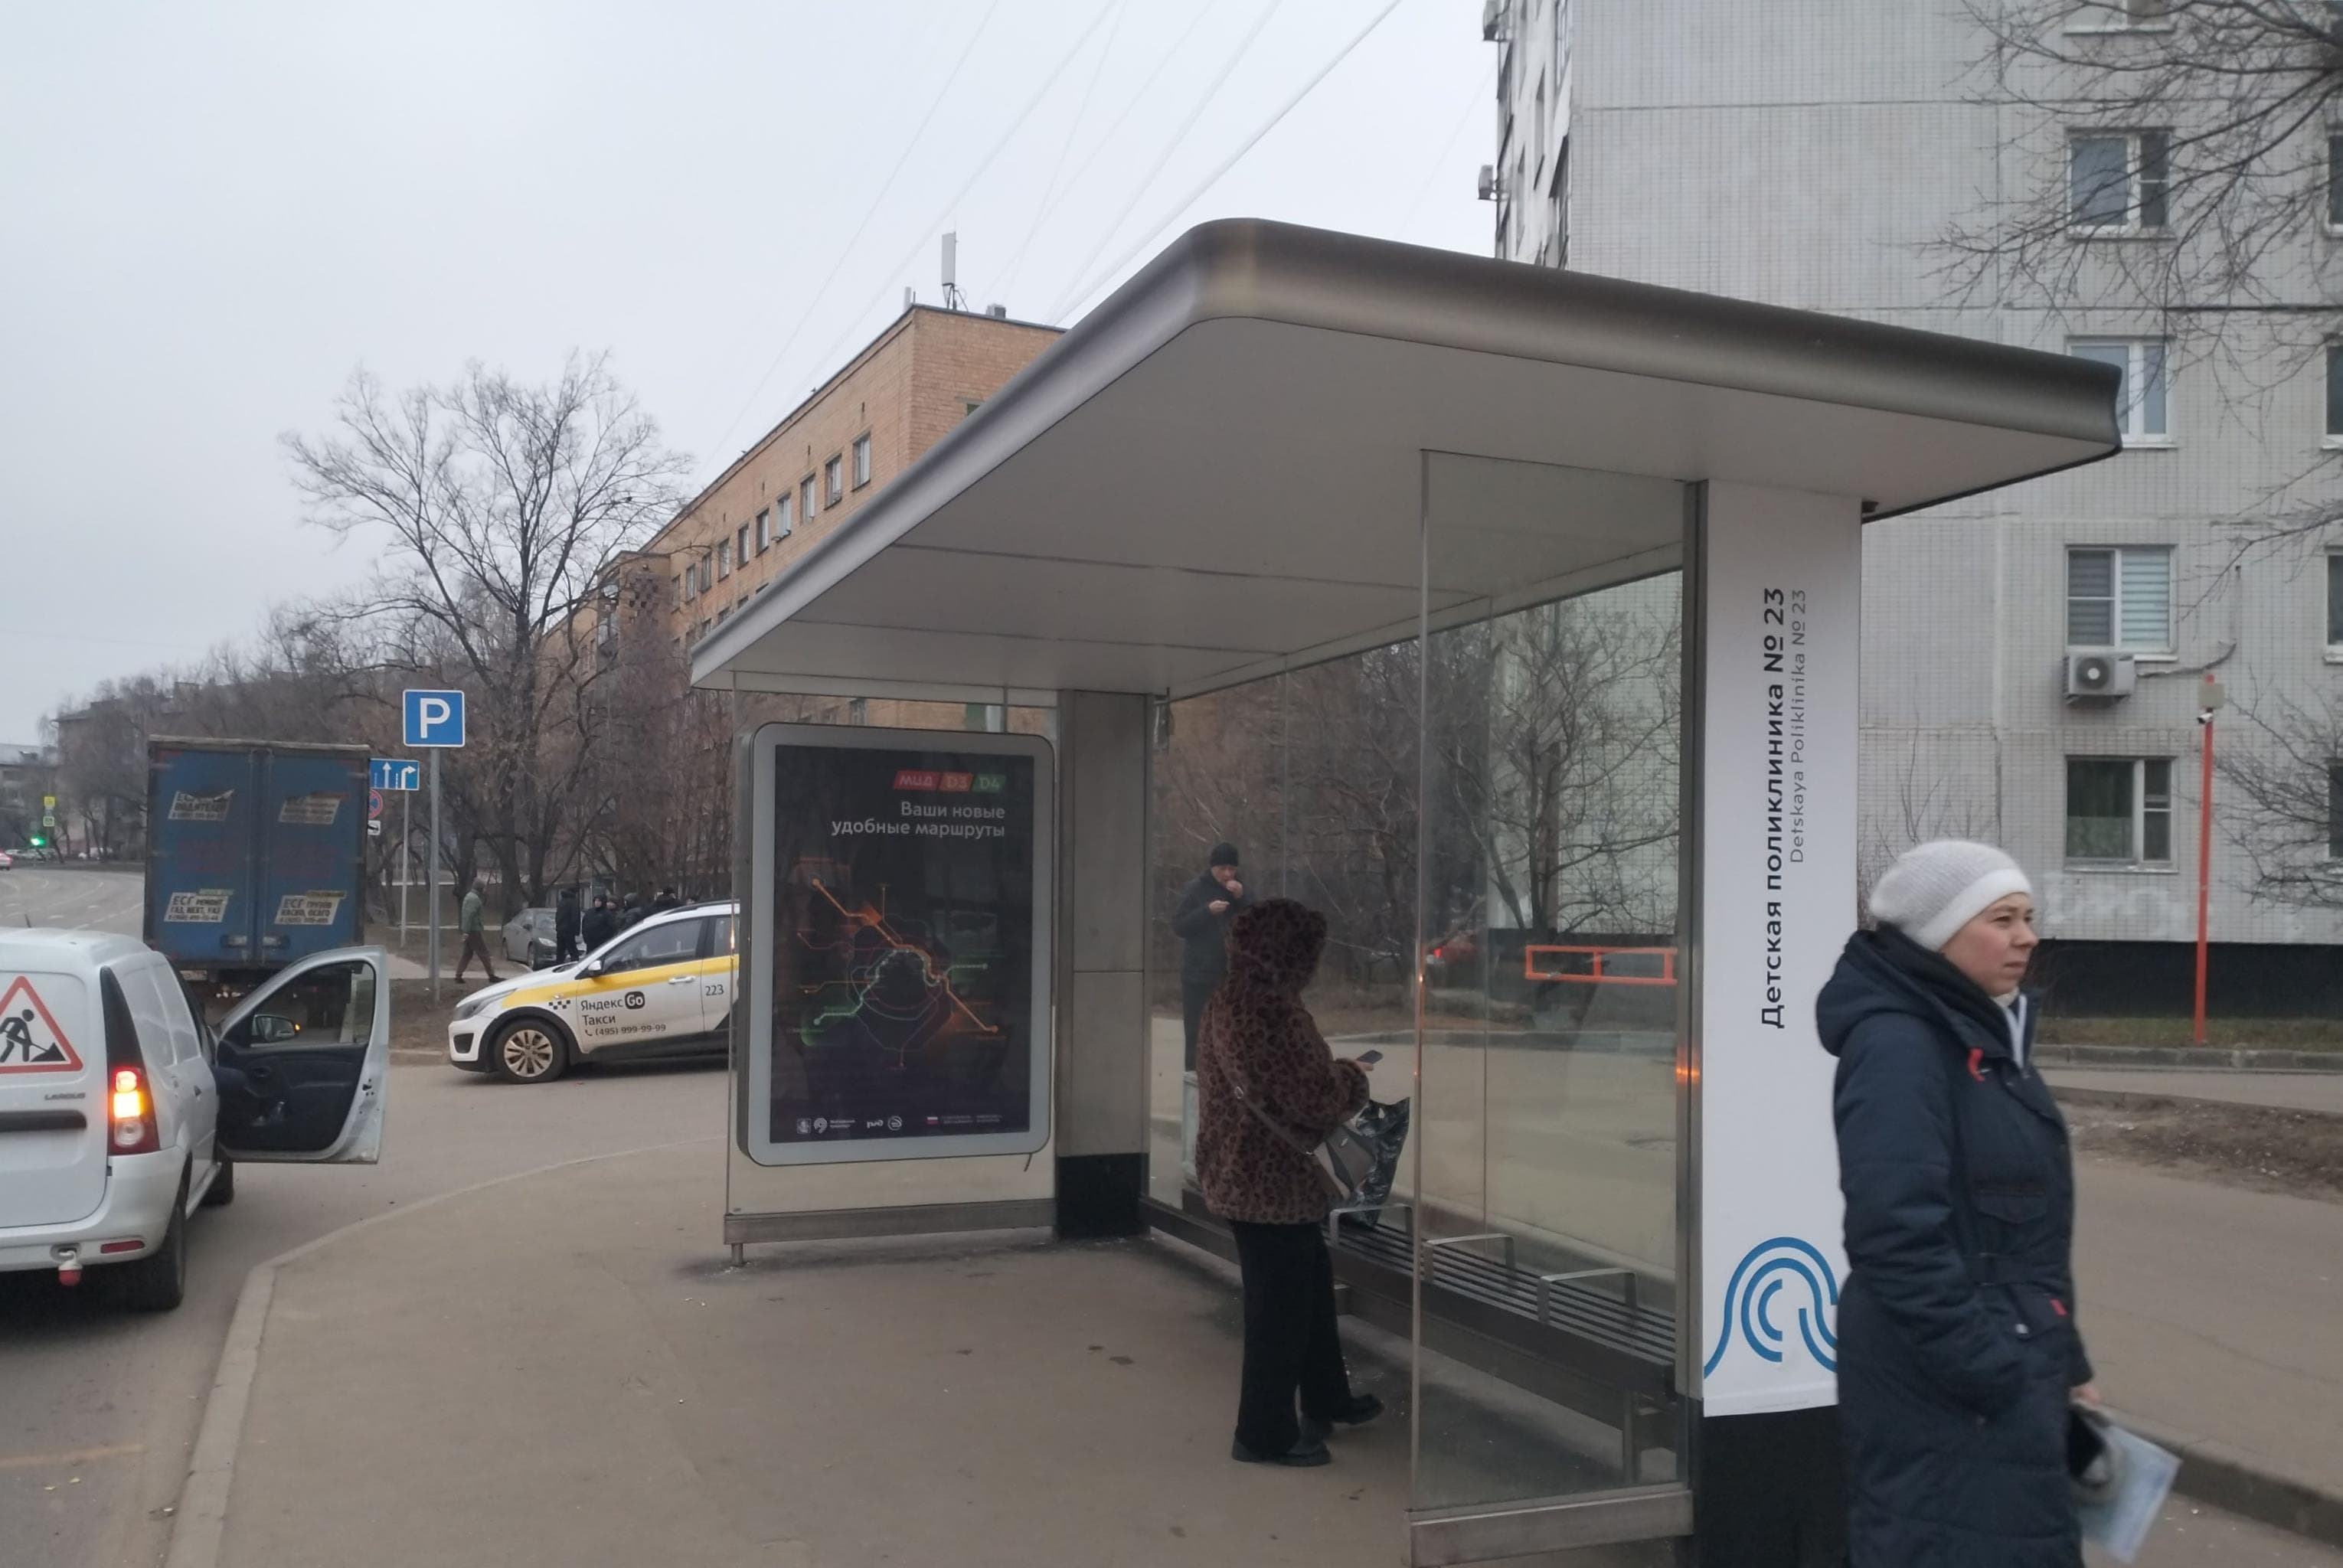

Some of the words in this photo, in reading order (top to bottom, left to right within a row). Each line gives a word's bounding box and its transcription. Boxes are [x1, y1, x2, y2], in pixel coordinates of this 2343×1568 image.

[1763, 587, 1784, 626] 23
[1792, 590, 1806, 614] 23
[1763, 634, 1784, 673] №
[420, 697, 450, 739] P
[1790, 653, 1805, 764] Poliklinika
[899, 774, 934, 787] МЦД
[946, 775, 968, 789] D3
[979, 776, 1001, 790] D4
[1767, 684, 1784, 890] поликлиника
[900, 801, 948, 818] Ваши
[952, 804, 1006, 819] новые
[1790, 770, 1807, 863] Detskaya
[831, 818, 911, 836] удобные
[915, 823, 1005, 840] маршруты
[1761, 901, 1785, 1029] Детская
[580, 998, 623, 1011] Яндекс
[626, 992, 644, 1008] Go
[705, 984, 725, 996] 223
[582, 1014, 616, 1026] Такси
[595, 1027, 619, 1036] (495)
[621, 1024, 667, 1034] 999-99-99
